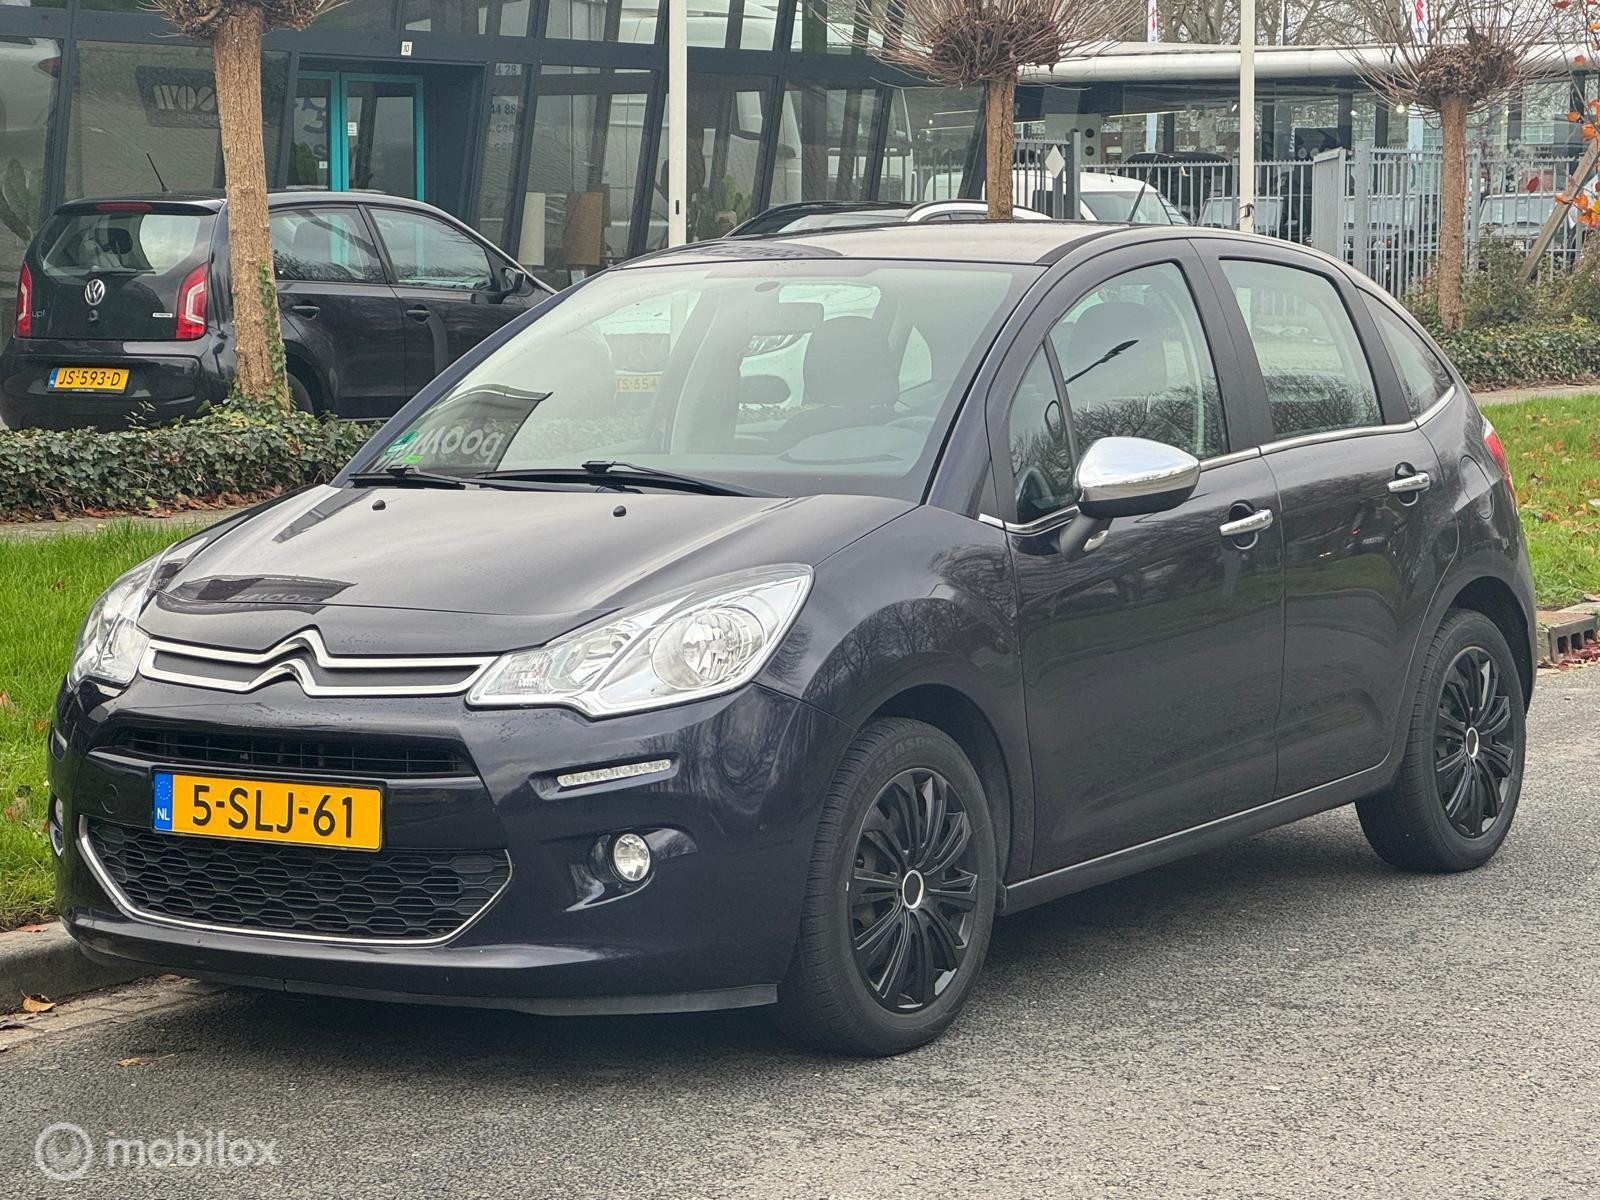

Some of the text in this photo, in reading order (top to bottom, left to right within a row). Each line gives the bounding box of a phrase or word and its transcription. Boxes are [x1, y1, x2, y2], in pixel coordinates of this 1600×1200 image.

[59, 370, 121, 387] JS-593-D
[157, 807, 170, 821] NL
[192, 784, 353, 838] 5-SLJ-61
